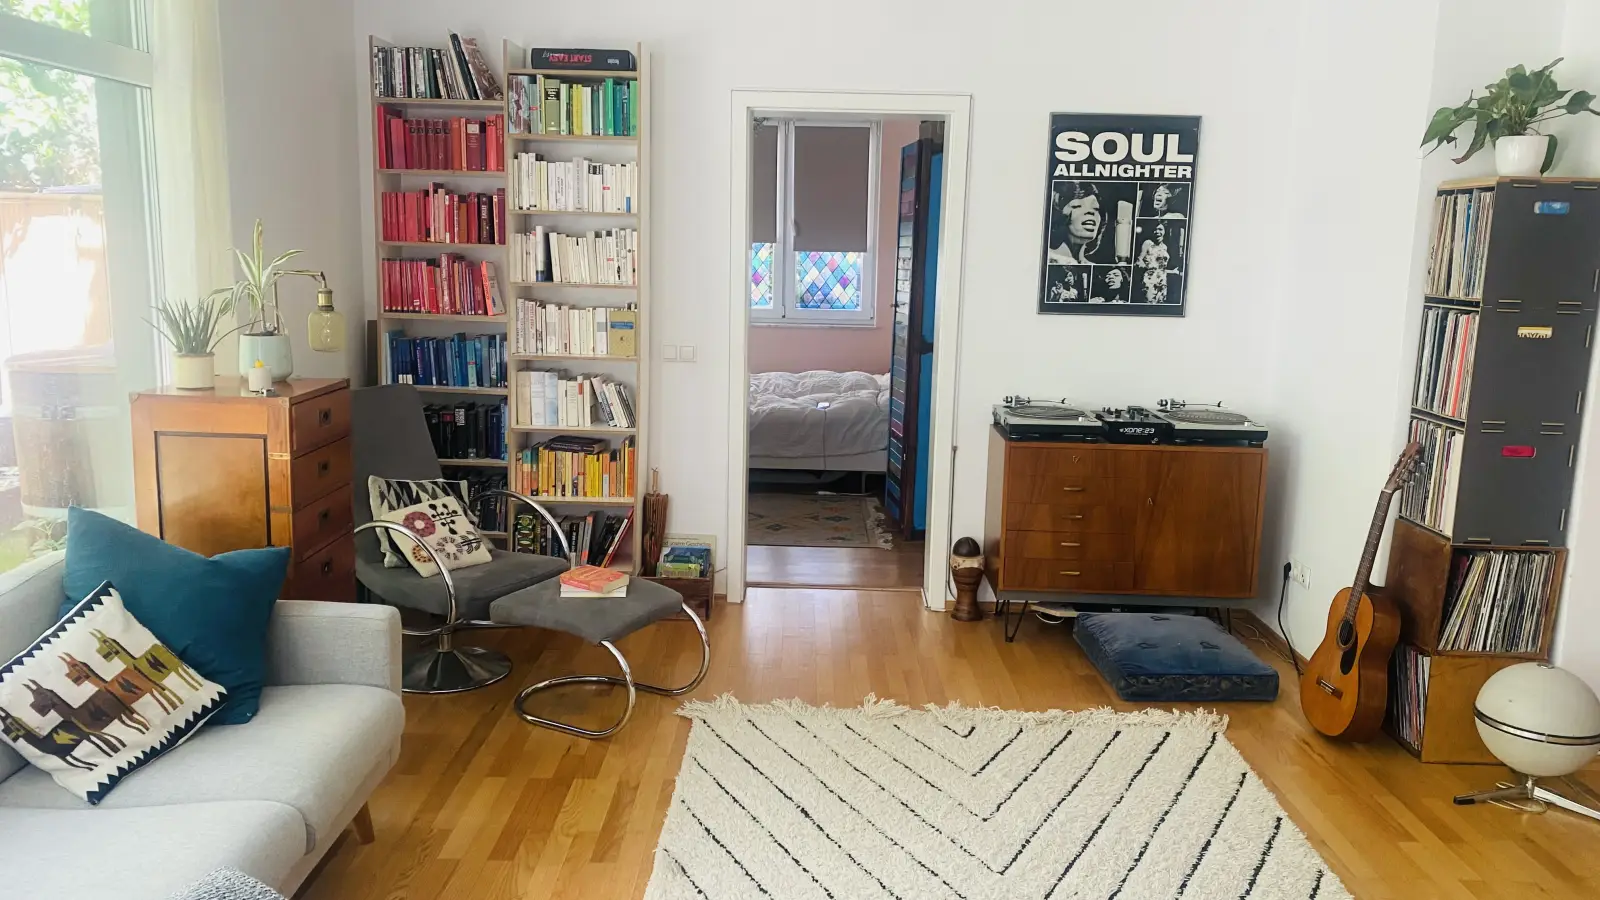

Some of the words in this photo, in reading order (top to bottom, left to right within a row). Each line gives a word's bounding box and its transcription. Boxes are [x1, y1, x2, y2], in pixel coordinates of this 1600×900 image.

[570, 54, 592, 63] START
[1054, 131, 1194, 163] SOUL
[1053, 164, 1192, 178] ALLNIGHTER
